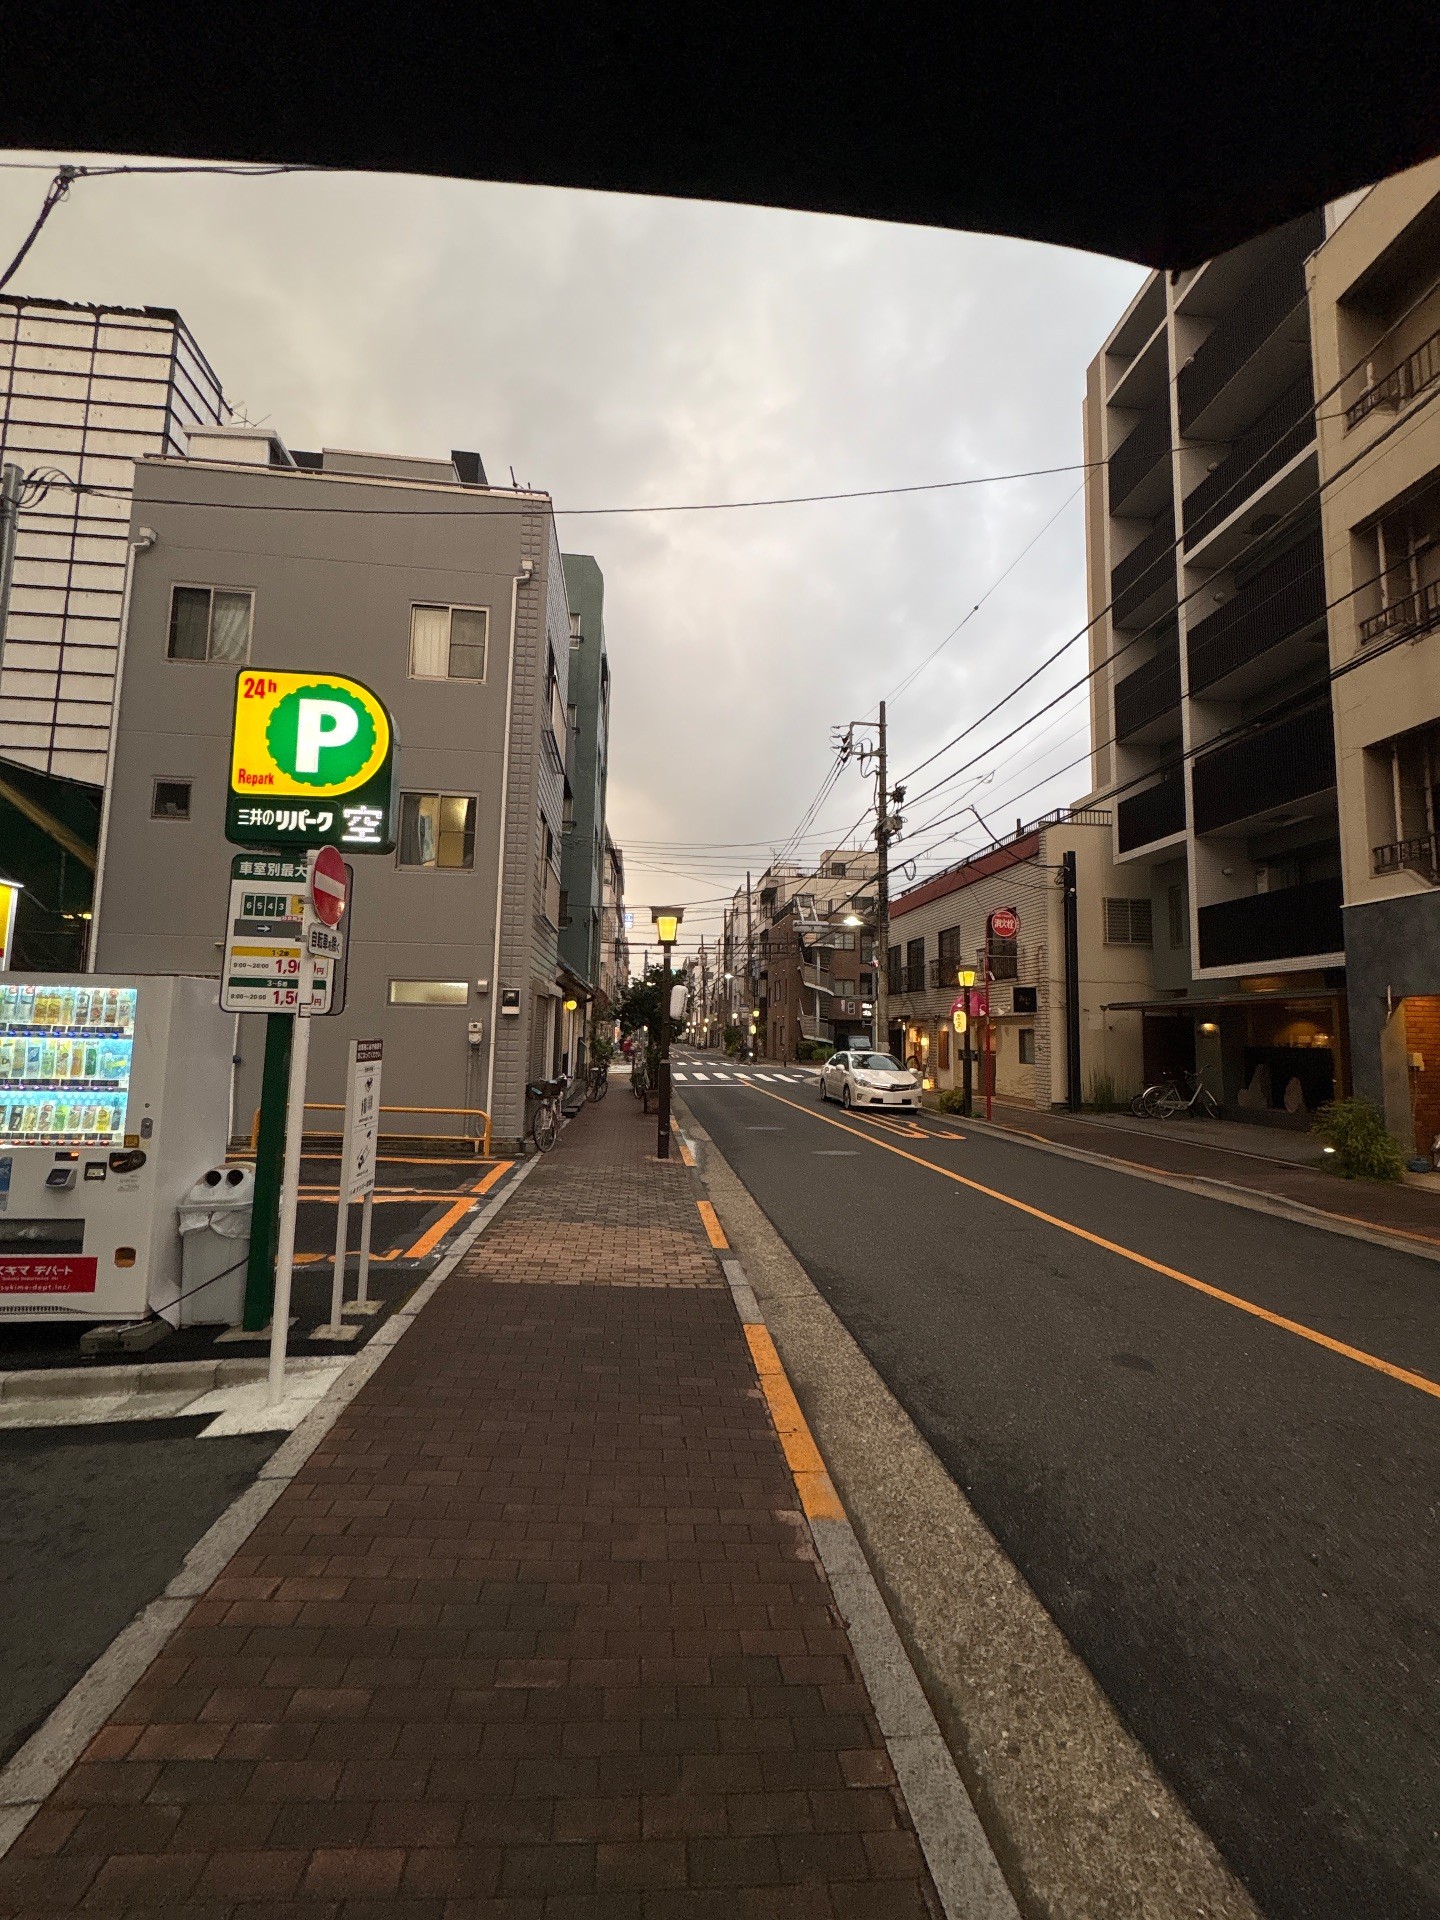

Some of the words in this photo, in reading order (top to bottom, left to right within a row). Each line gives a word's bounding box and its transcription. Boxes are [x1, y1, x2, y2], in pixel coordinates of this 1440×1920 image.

[243, 677, 277, 699] 24h
[295, 698, 359, 773] P
[238, 768, 274, 787] Repark
[238, 808, 333, 832] 三井のリパーク
[342, 805, 383, 843] 空
[239, 861, 308, 878] 車室別最大
[246, 901, 253, 910] 6
[257, 902, 264, 910] 5
